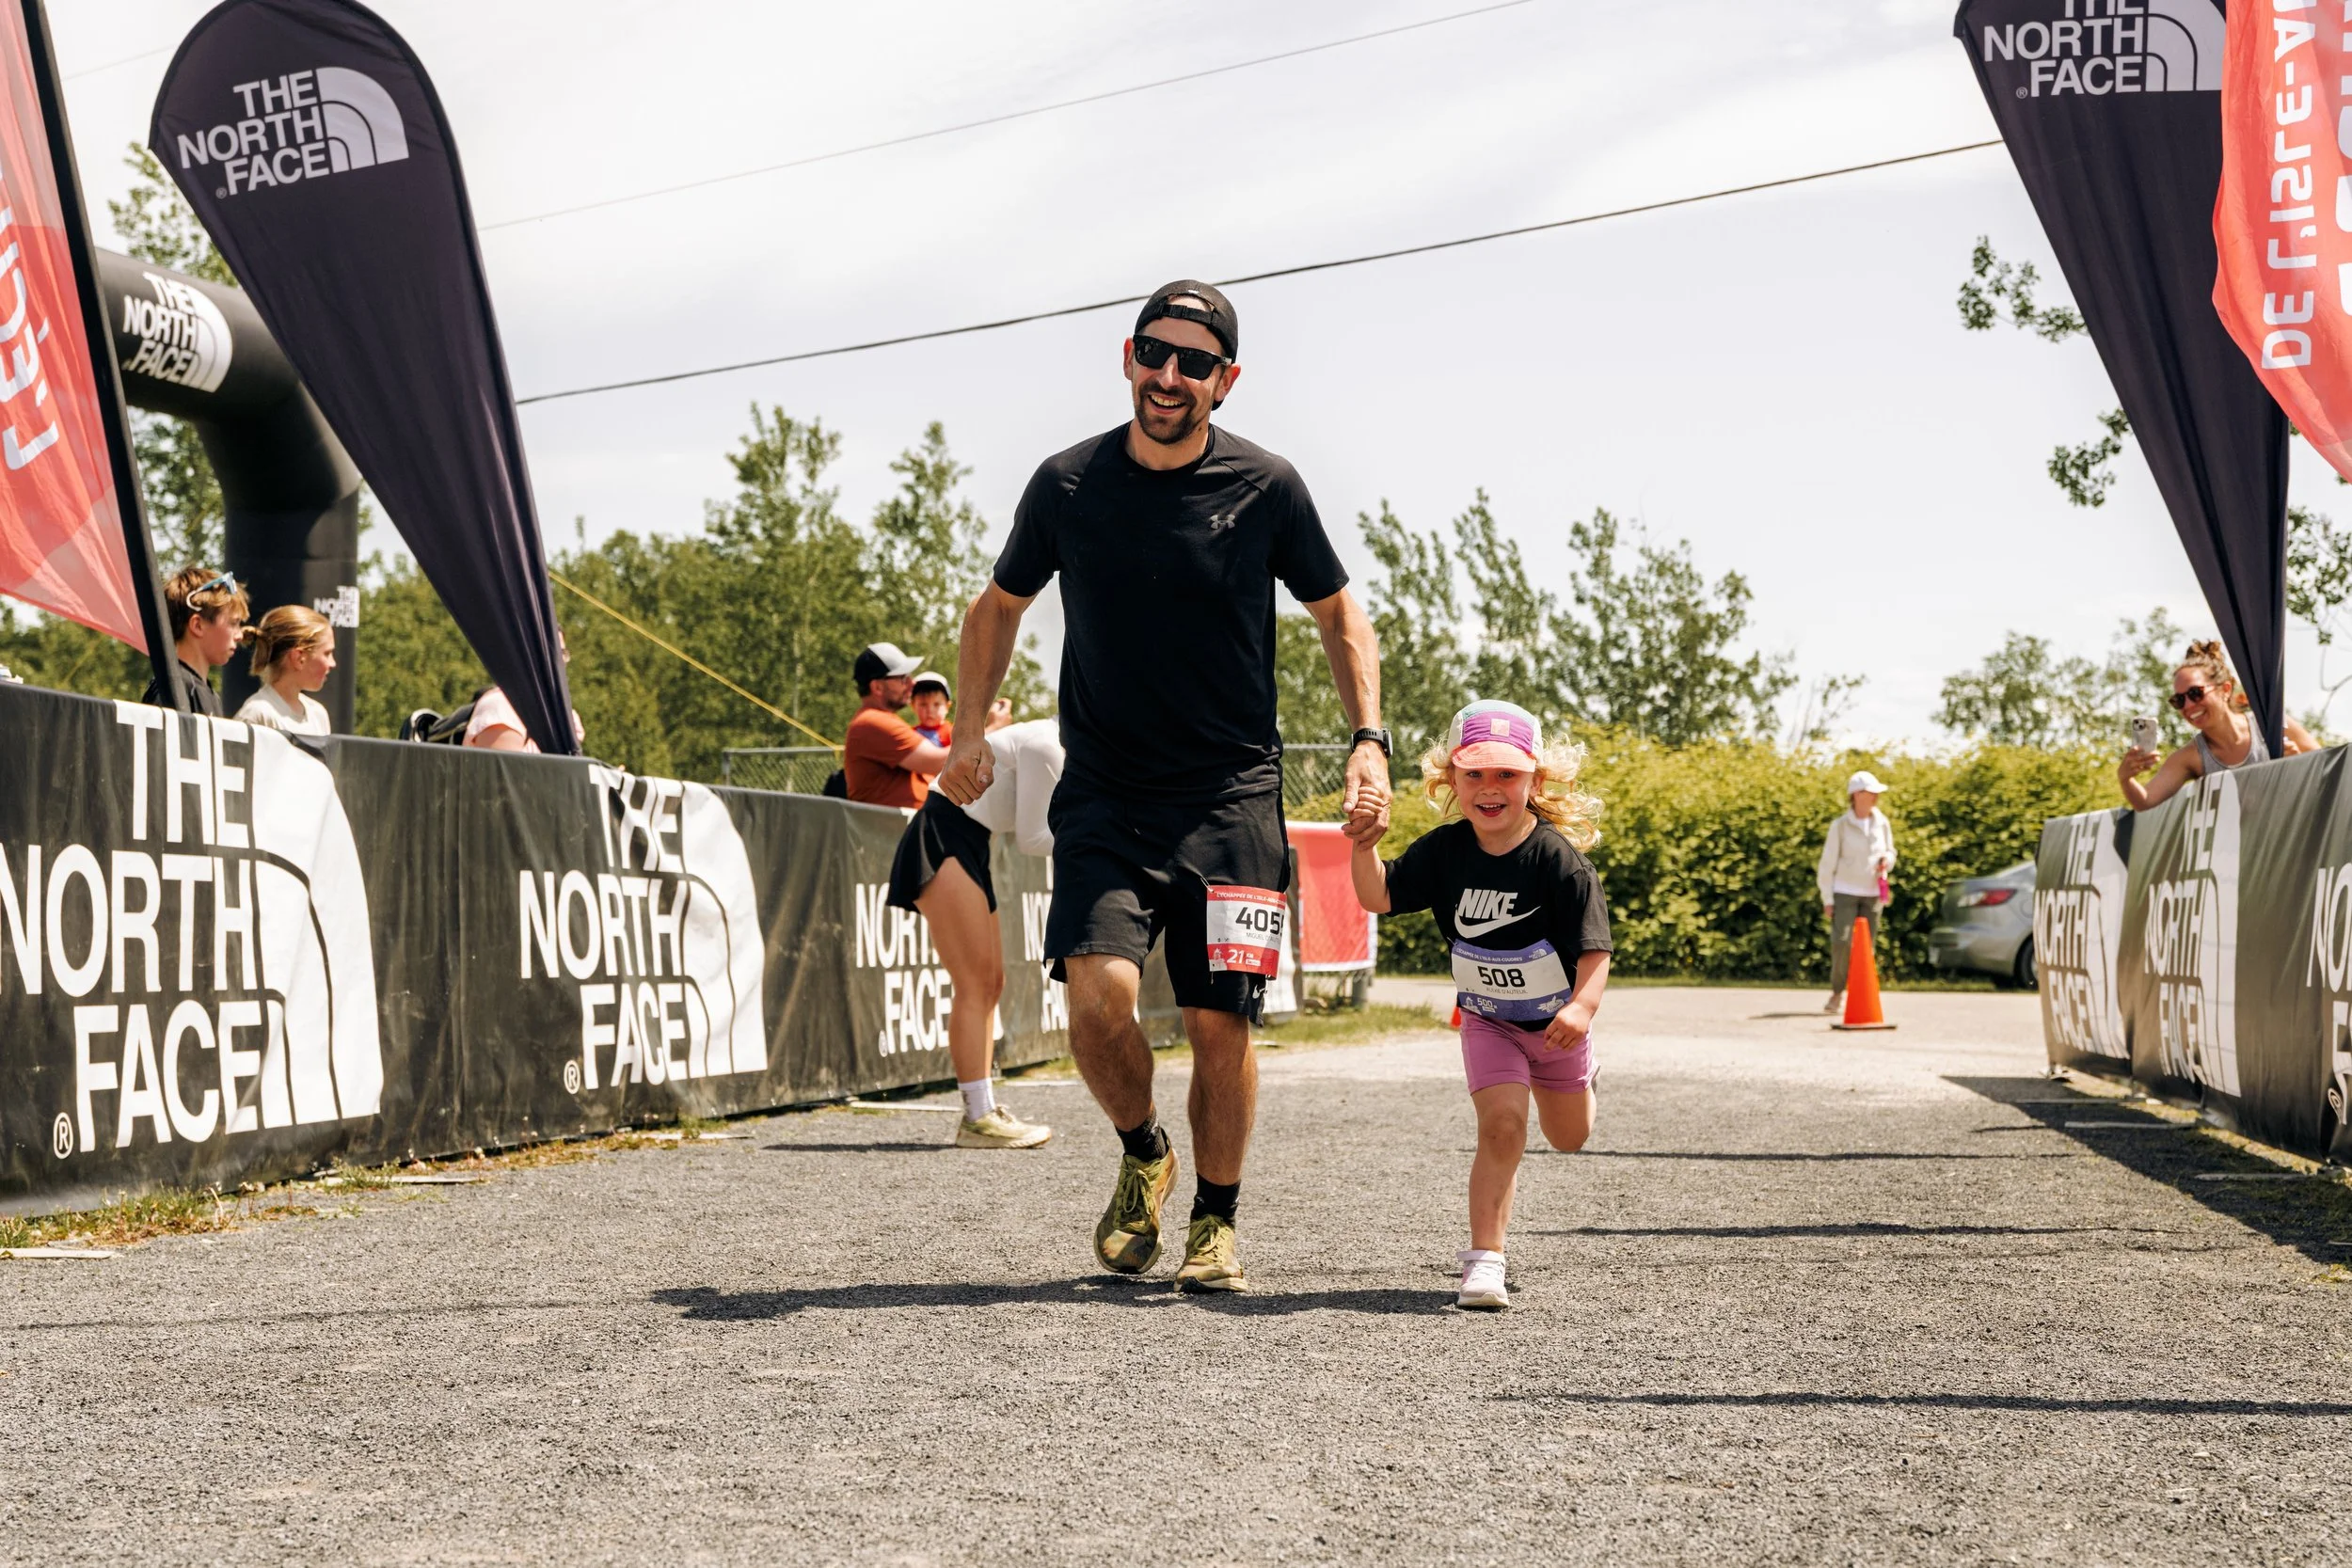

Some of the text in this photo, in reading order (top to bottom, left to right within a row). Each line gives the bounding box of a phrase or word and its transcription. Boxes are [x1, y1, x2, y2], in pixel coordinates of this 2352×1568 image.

[1984, 17, 2144, 62] NORTH
[232, 70, 318, 118] THE
[2030, 55, 2143, 98] FACE
[177, 105, 324, 169] NORTH
[224, 141, 330, 196] FACE
[122, 294, 198, 351] NORTH
[143, 271, 196, 315] THE
[129, 340, 192, 382] FACE
[115, 700, 250, 848] THE
[589, 764, 685, 873] THE
[2064, 813, 2101, 886] THE
[2179, 770, 2222, 872] THE
[0, 842, 258, 997] NORTH
[519, 869, 690, 980] NORTH
[1458, 888, 1518, 919] NIKE
[2032, 888, 2090, 970] NORTH
[2145, 877, 2207, 976] NORTH
[1226, 948, 1245, 964] 21
[1477, 965, 1526, 988] 508
[580, 981, 688, 1090] FACE
[884, 968, 952, 1054] FACE
[1477, 997, 1493, 1007] 500
[2048, 970, 2092, 1052] FACE
[2159, 982, 2200, 1084] FACE
[73, 999, 262, 1153] FACE
